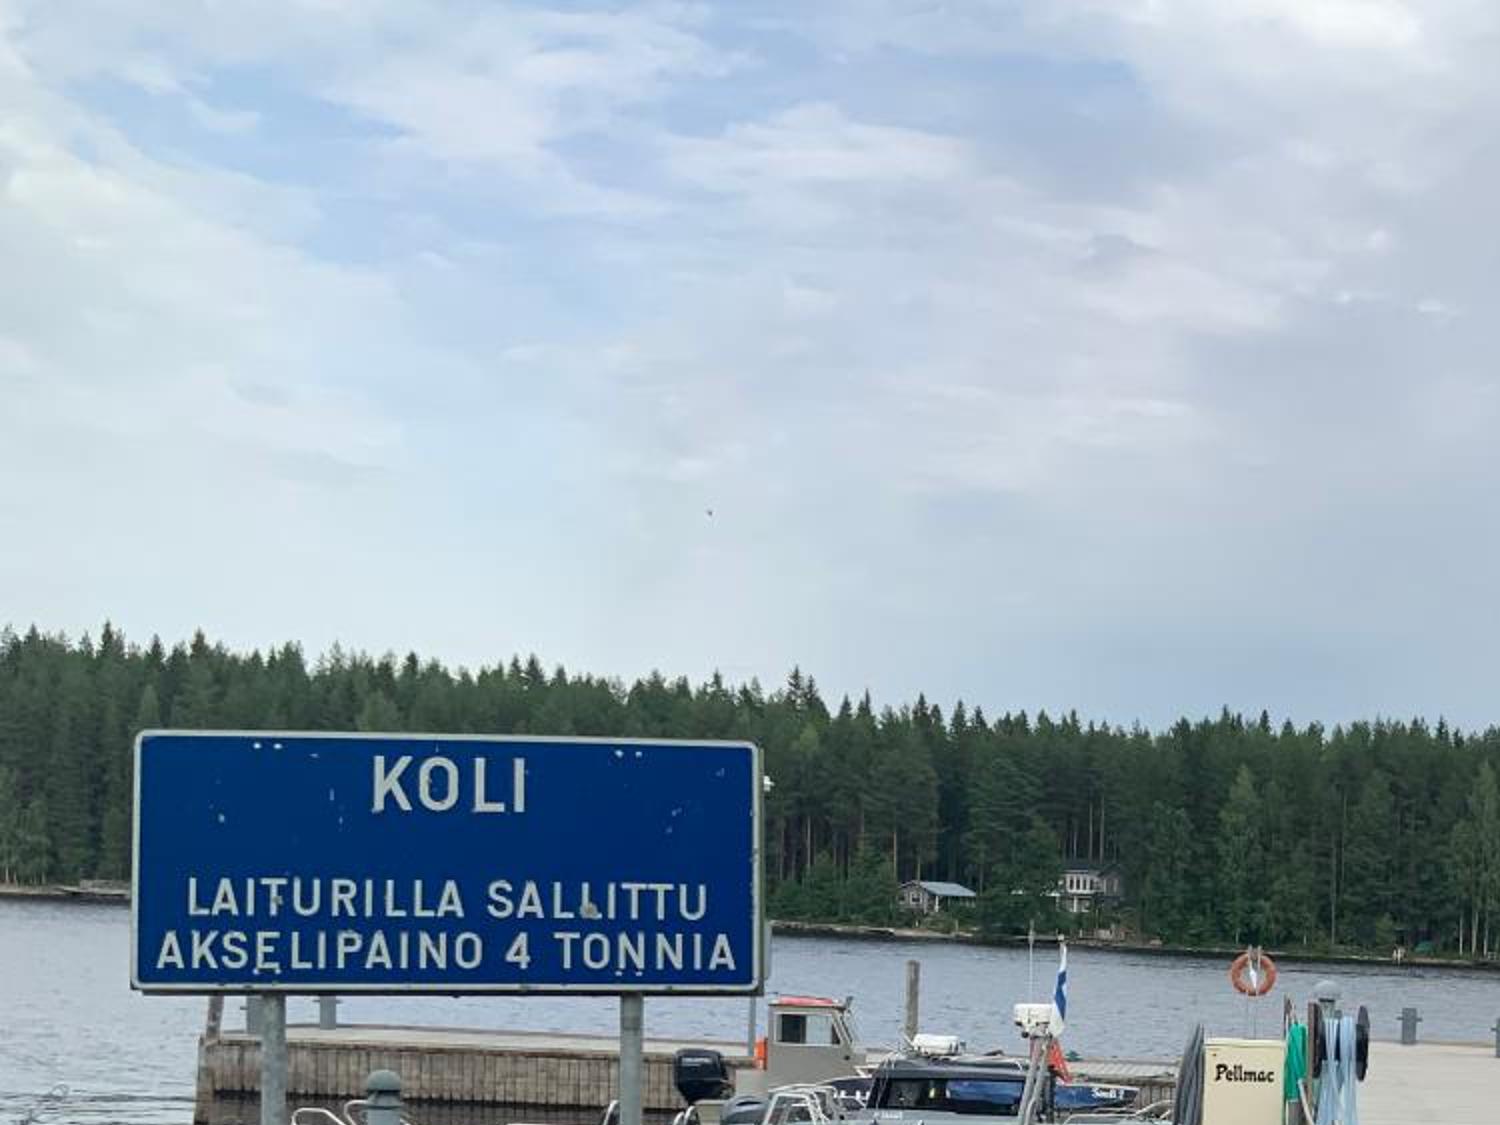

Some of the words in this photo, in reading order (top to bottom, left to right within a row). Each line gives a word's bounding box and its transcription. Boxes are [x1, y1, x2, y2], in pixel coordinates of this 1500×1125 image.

[372, 755, 526, 814] KOLI
[187, 876, 464, 918] LAITURILLA
[487, 880, 707, 921] SALLITTU
[156, 930, 483, 970] AKSELIPAINO
[505, 931, 532, 969] 4
[553, 932, 737, 970] TONNIA
